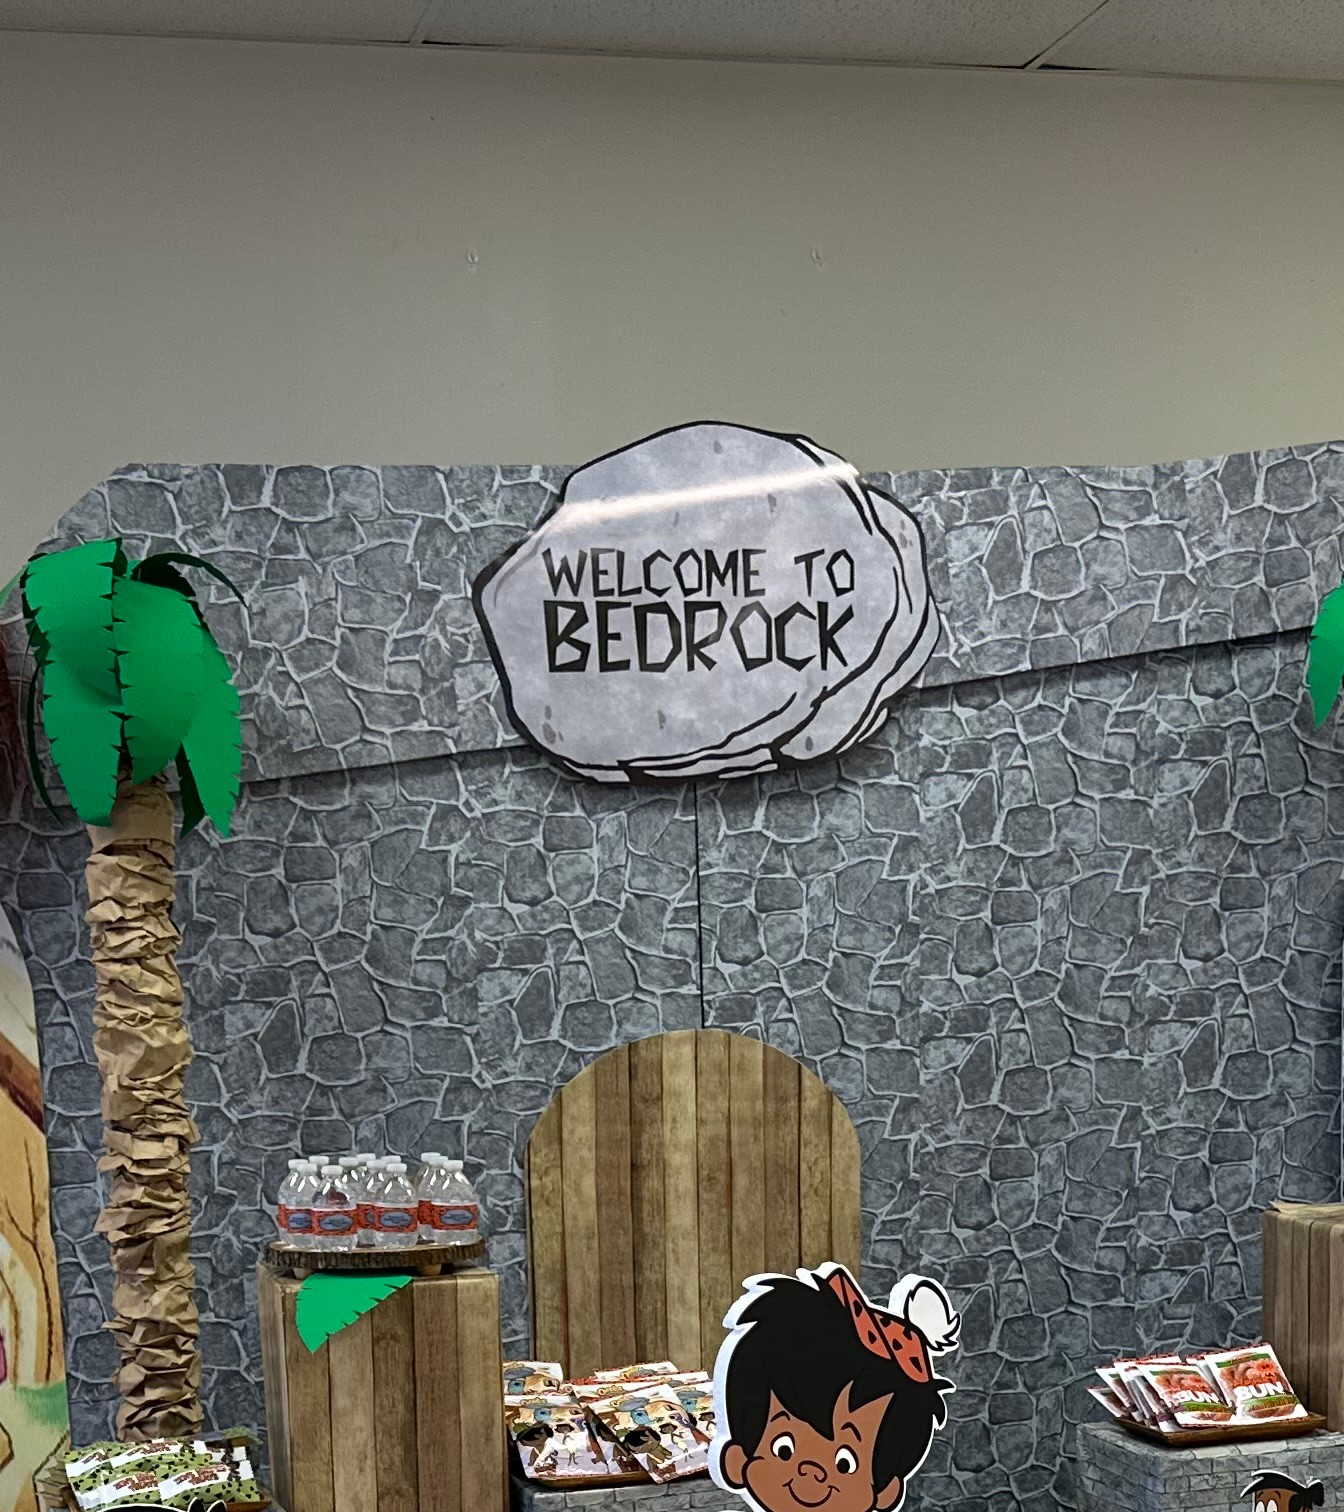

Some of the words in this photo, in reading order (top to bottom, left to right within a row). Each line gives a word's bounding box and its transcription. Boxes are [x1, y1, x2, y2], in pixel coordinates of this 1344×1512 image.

[541, 547, 767, 598] WELCOME
[794, 547, 855, 598] TO
[542, 600, 855, 673] BEDROCK
[1234, 1382, 1284, 1400] BUN
